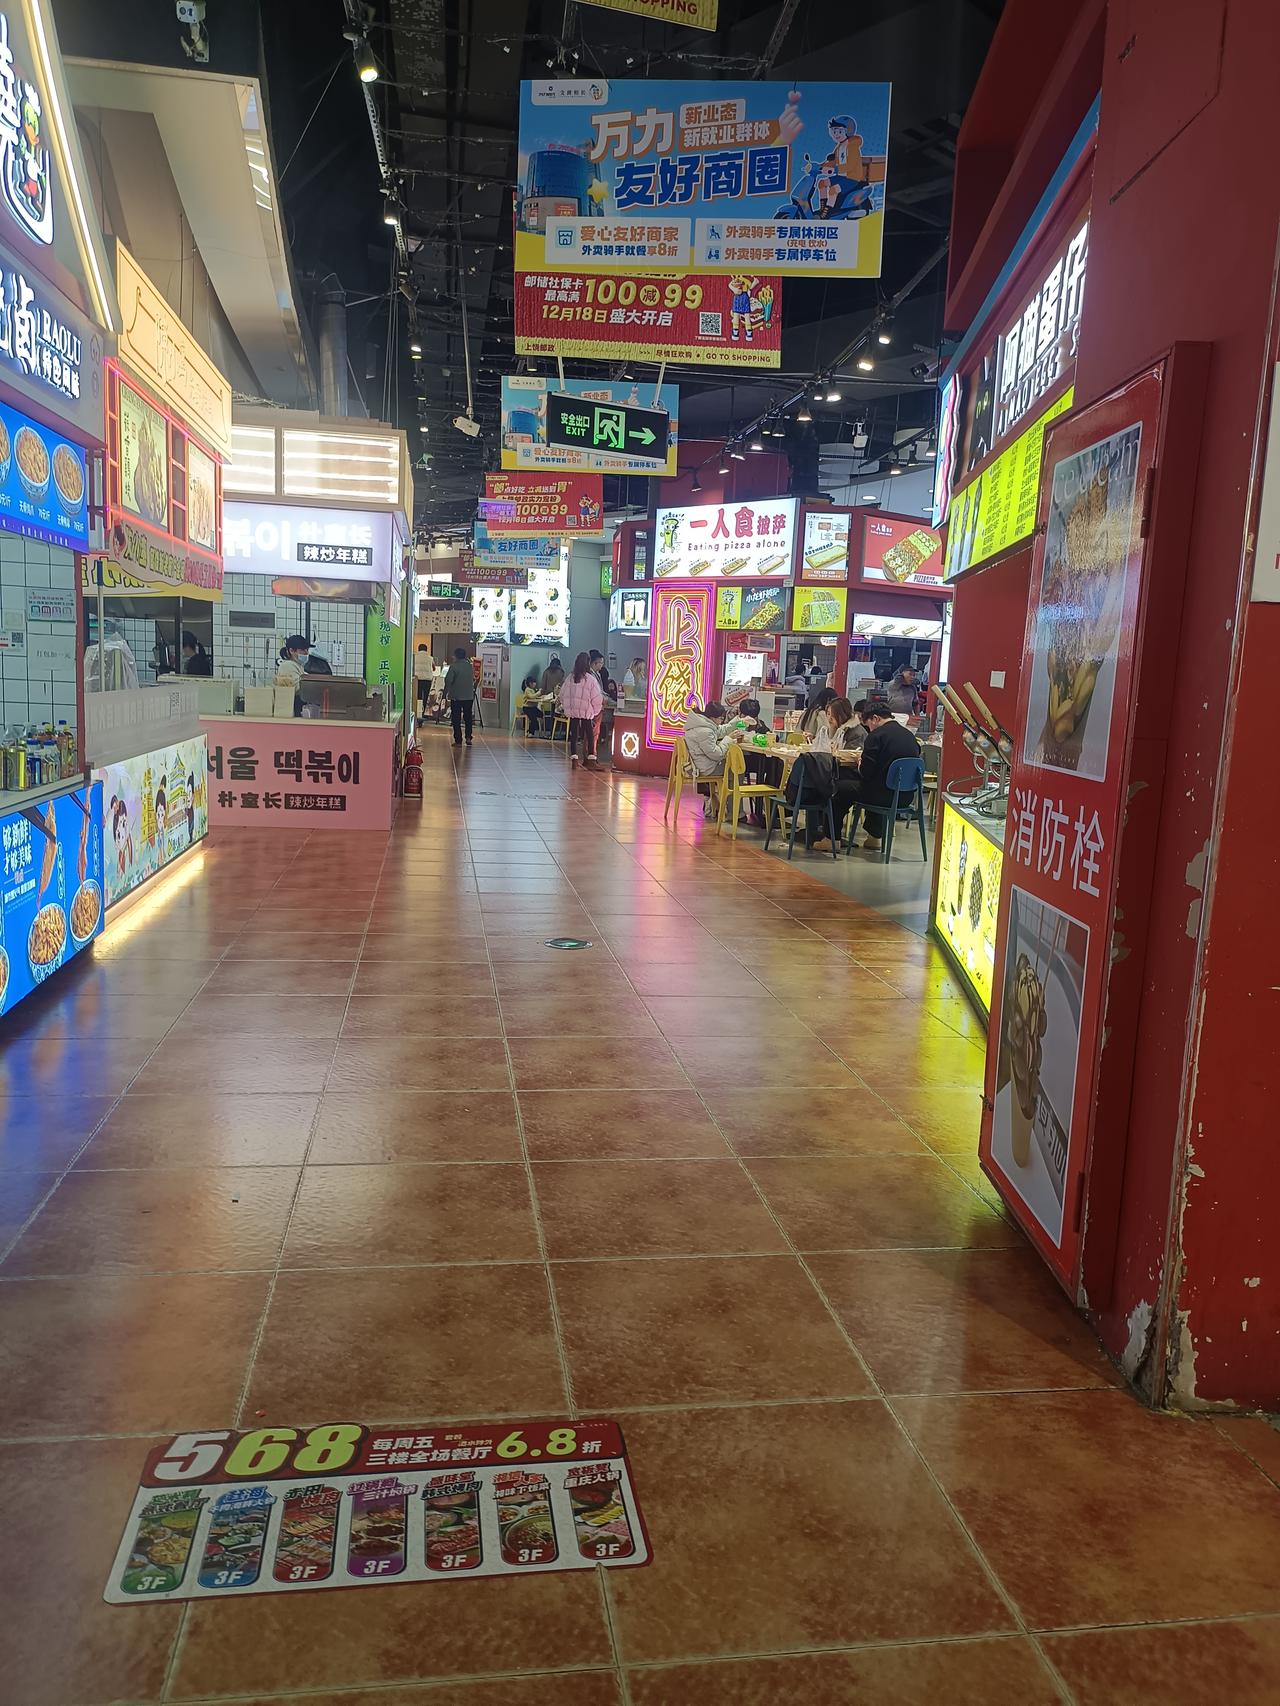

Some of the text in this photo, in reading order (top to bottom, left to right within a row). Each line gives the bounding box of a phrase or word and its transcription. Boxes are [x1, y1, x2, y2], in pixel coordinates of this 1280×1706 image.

[684, 103, 738, 124] 新业态
[591, 108, 674, 162] 万力
[683, 121, 770, 147] 新就业群体
[614, 145, 791, 210] 友好商圈
[580, 225, 679, 242] 爱心友好商家
[725, 226, 839, 240] 外卖骑手专属休闲区
[581, 242, 679, 257] 外卖骑手就餐享8折
[724, 248, 837, 262] 外卖骑手专属停车位
[524, 275, 583, 288] 邮储社保卡
[544, 289, 580, 303] 最高满
[542, 305, 673, 326] 12月18日盛大开启
[43, 309, 81, 366] RAOLU
[732, 354, 771, 363] SHOPPING
[560, 412, 590, 428] 安全出口
[565, 426, 586, 437] EXIT
[690, 506, 786, 539] 一人食披萨
[687, 539, 786, 552] Eating pizza alone
[303, 545, 368, 564] 辣炒年糕
[379, 660, 391, 685] 正宗
[274, 749, 360, 785] 떡볶이
[218, 790, 282, 809] 朴室长
[289, 795, 342, 809] 辣炒年糕
[1009, 787, 1104, 898] 消防栓
[372, 1435, 435, 1450] 每周五
[153, 1424, 363, 1481] 568
[365, 1447, 493, 1467] 三楼全场餐厅
[563, 1471, 621, 1488] 重庆火锅
[518, 1549, 543, 1562] 3F
[595, 1543, 620, 1557] 3F
[363, 1560, 391, 1574] 3F
[441, 1554, 467, 1568] 3F
[214, 1571, 244, 1585] 3F
[289, 1565, 318, 1580] 3F
[137, 1576, 166, 1591] 3F
